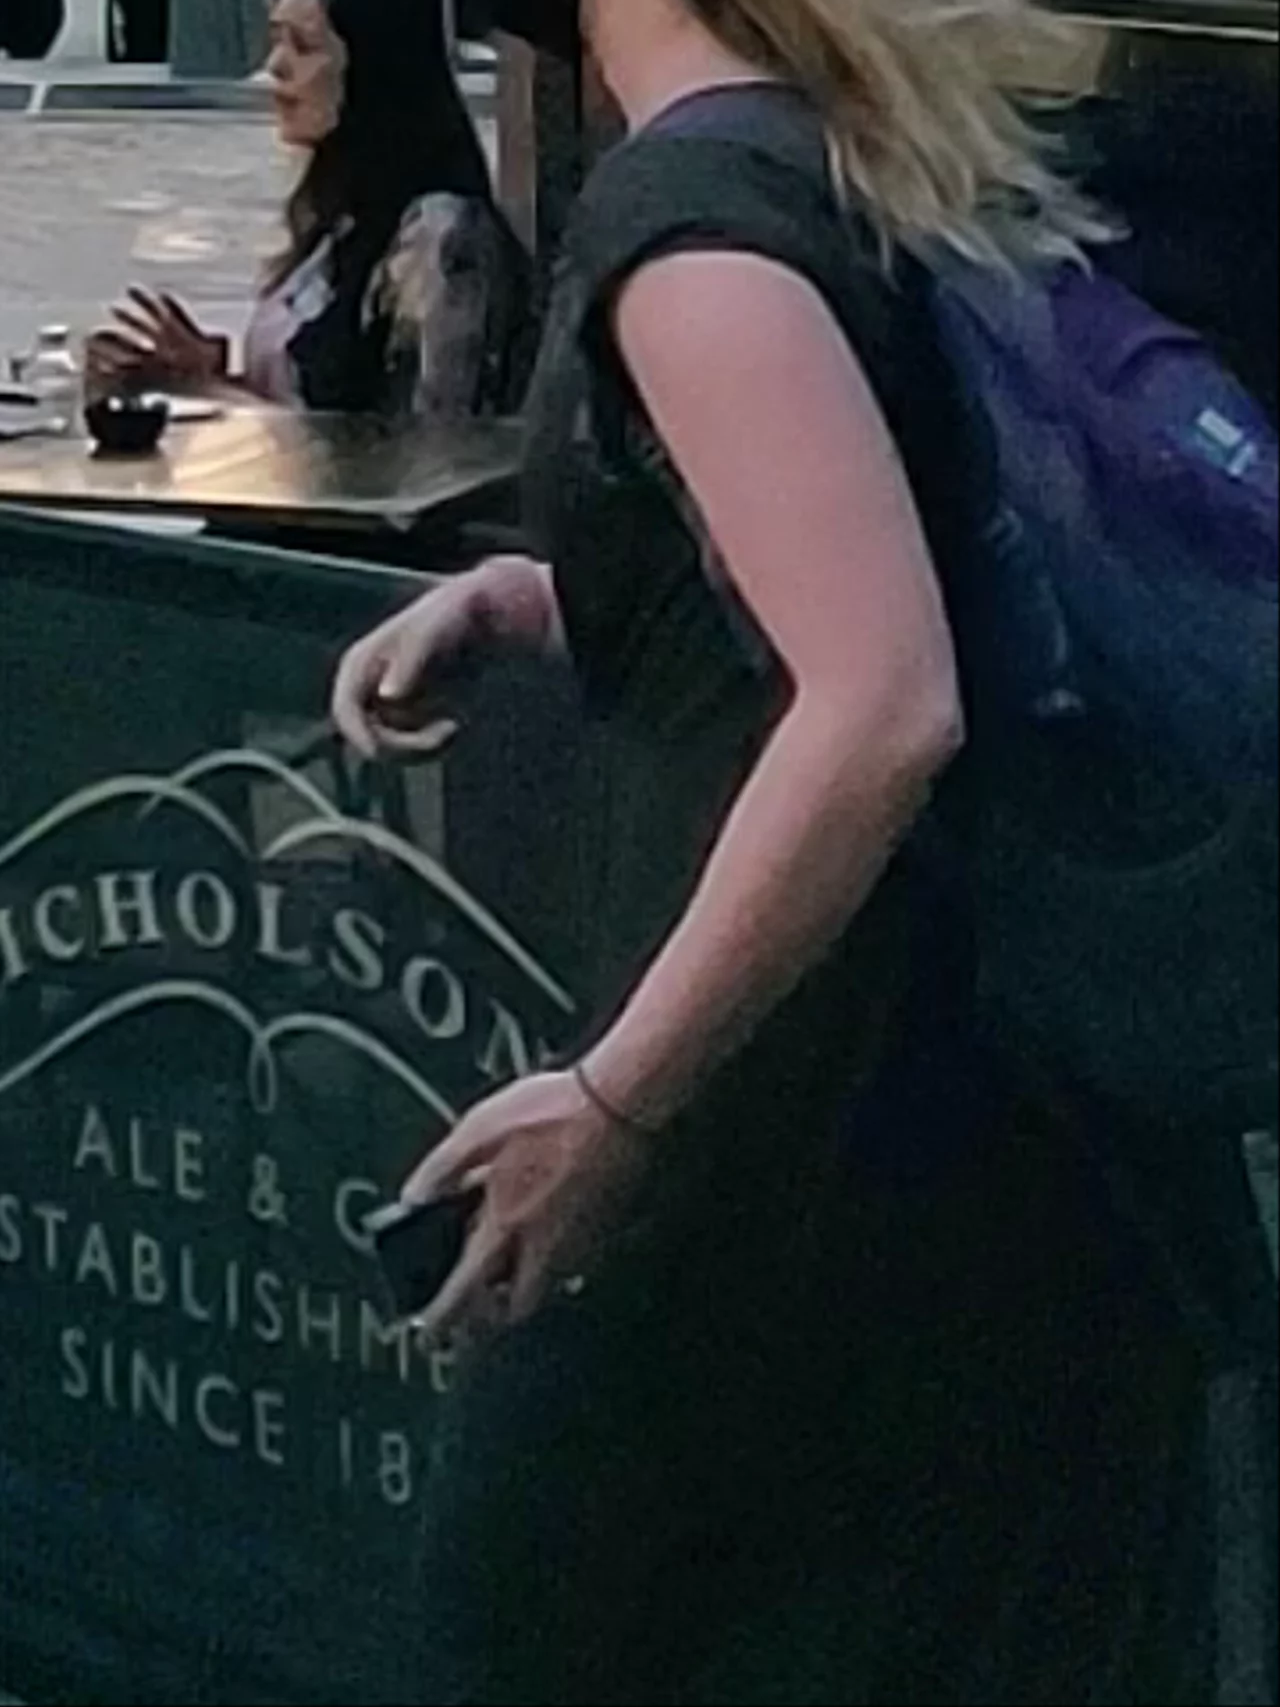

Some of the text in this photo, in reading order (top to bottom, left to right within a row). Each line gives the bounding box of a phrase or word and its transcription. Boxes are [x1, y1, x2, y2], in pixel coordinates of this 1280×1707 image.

[74, 1105, 207, 1202] ALE
[251, 1154, 287, 1230] &
[61, 1326, 412, 1506] SINCE 18
